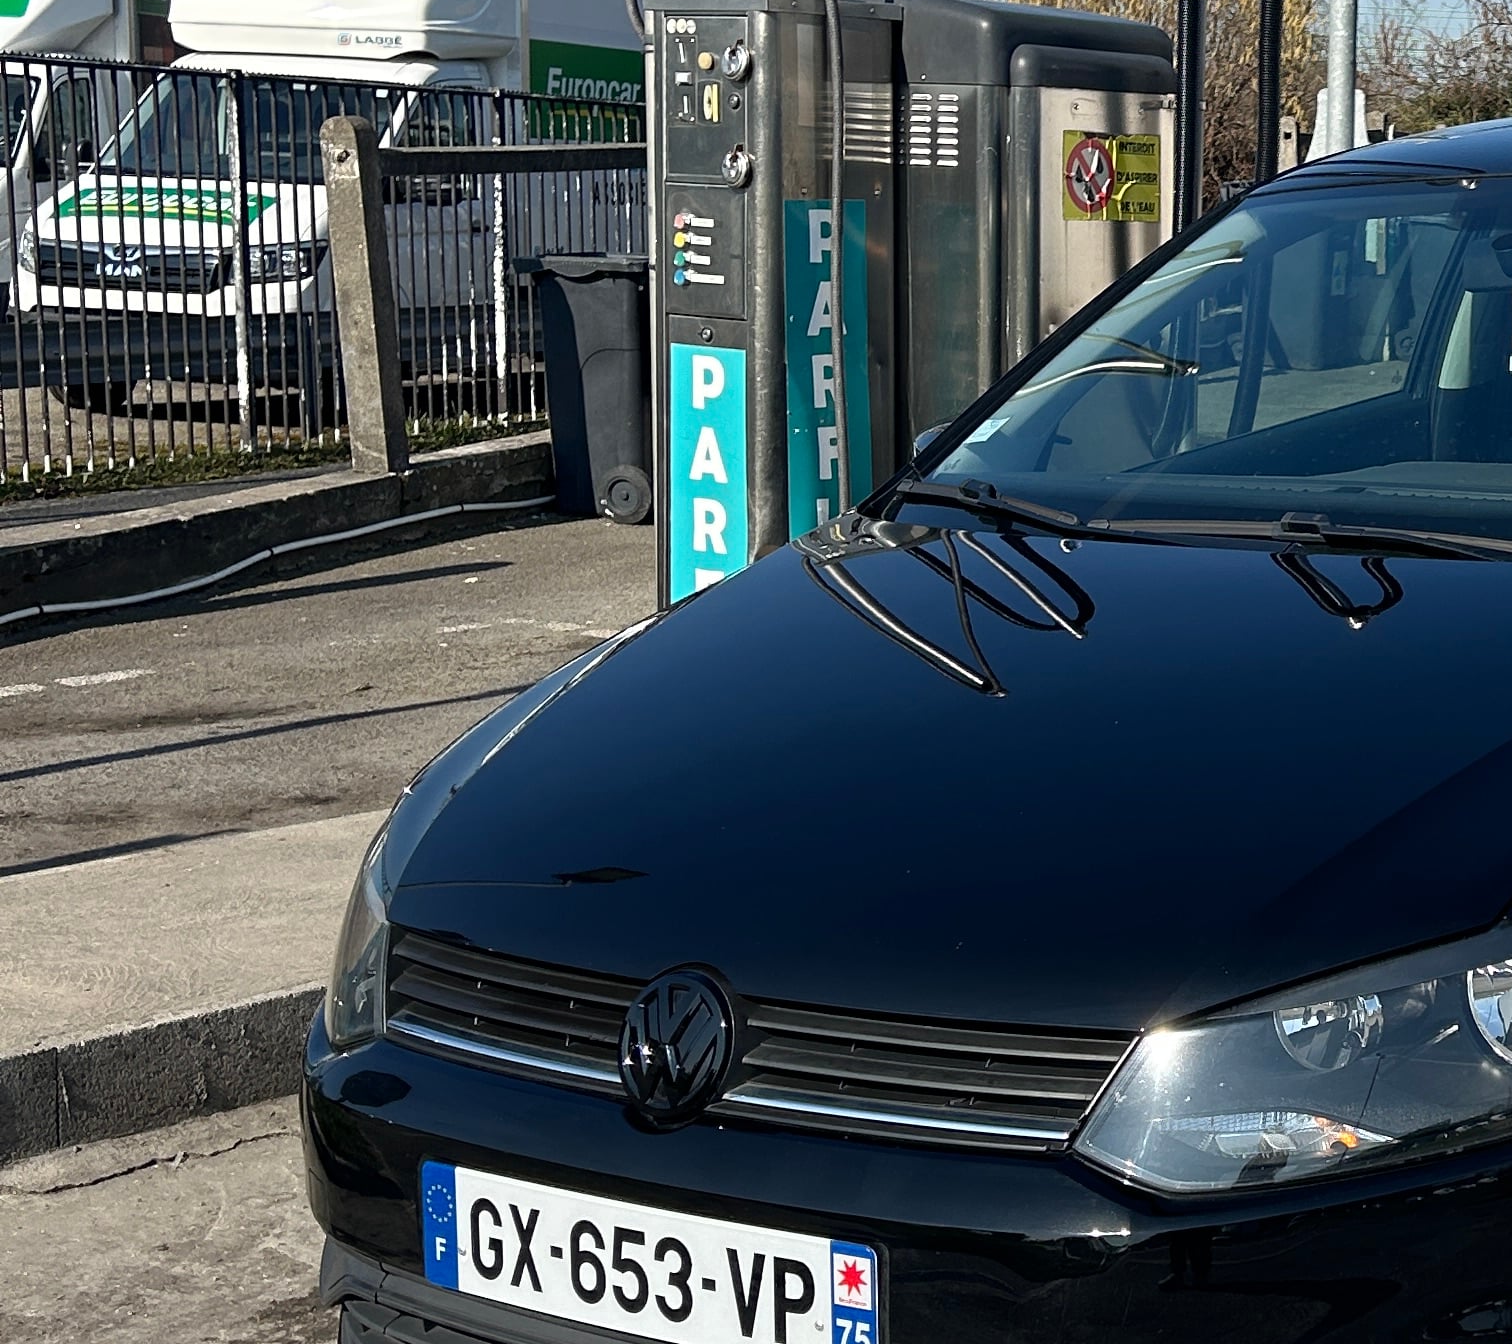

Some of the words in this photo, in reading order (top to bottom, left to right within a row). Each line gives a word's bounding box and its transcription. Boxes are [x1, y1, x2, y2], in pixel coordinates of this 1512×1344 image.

[547, 67, 641, 117] Europcar
[1118, 141, 1156, 153] INTERDIT
[1116, 171, 1158, 183] D'ASPIRER
[1120, 201, 1130, 212] DE
[435, 1237, 447, 1261] F
[470, 1197, 816, 1344] GX-653-VP
